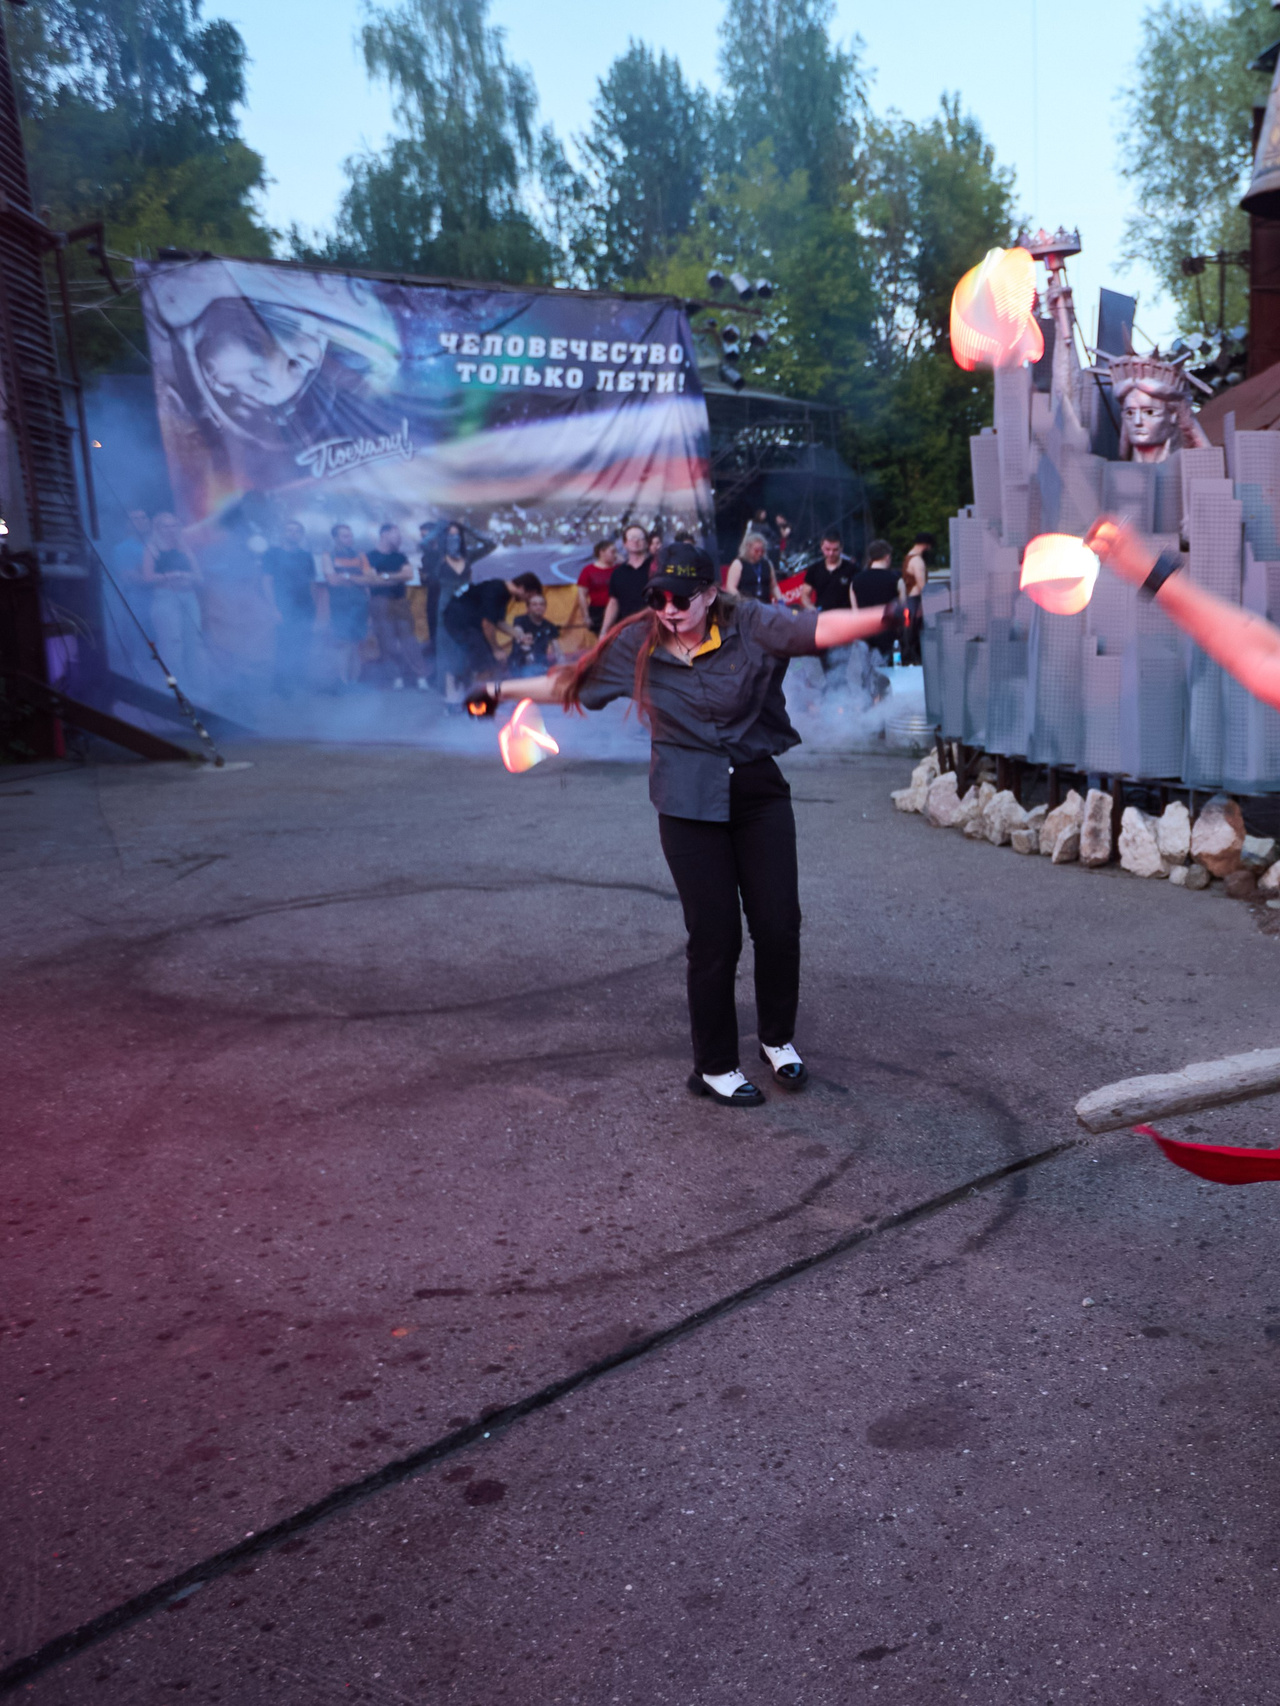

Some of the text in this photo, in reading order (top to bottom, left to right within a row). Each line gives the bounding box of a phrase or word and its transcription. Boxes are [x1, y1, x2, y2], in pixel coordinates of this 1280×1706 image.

[439, 332, 691, 368] ЧЕЛОВЕЧЕСТВО,
[456, 362, 686, 394] ТОЛЬКО ЛЕТИ!
[296, 416, 414, 478] Поехали!
